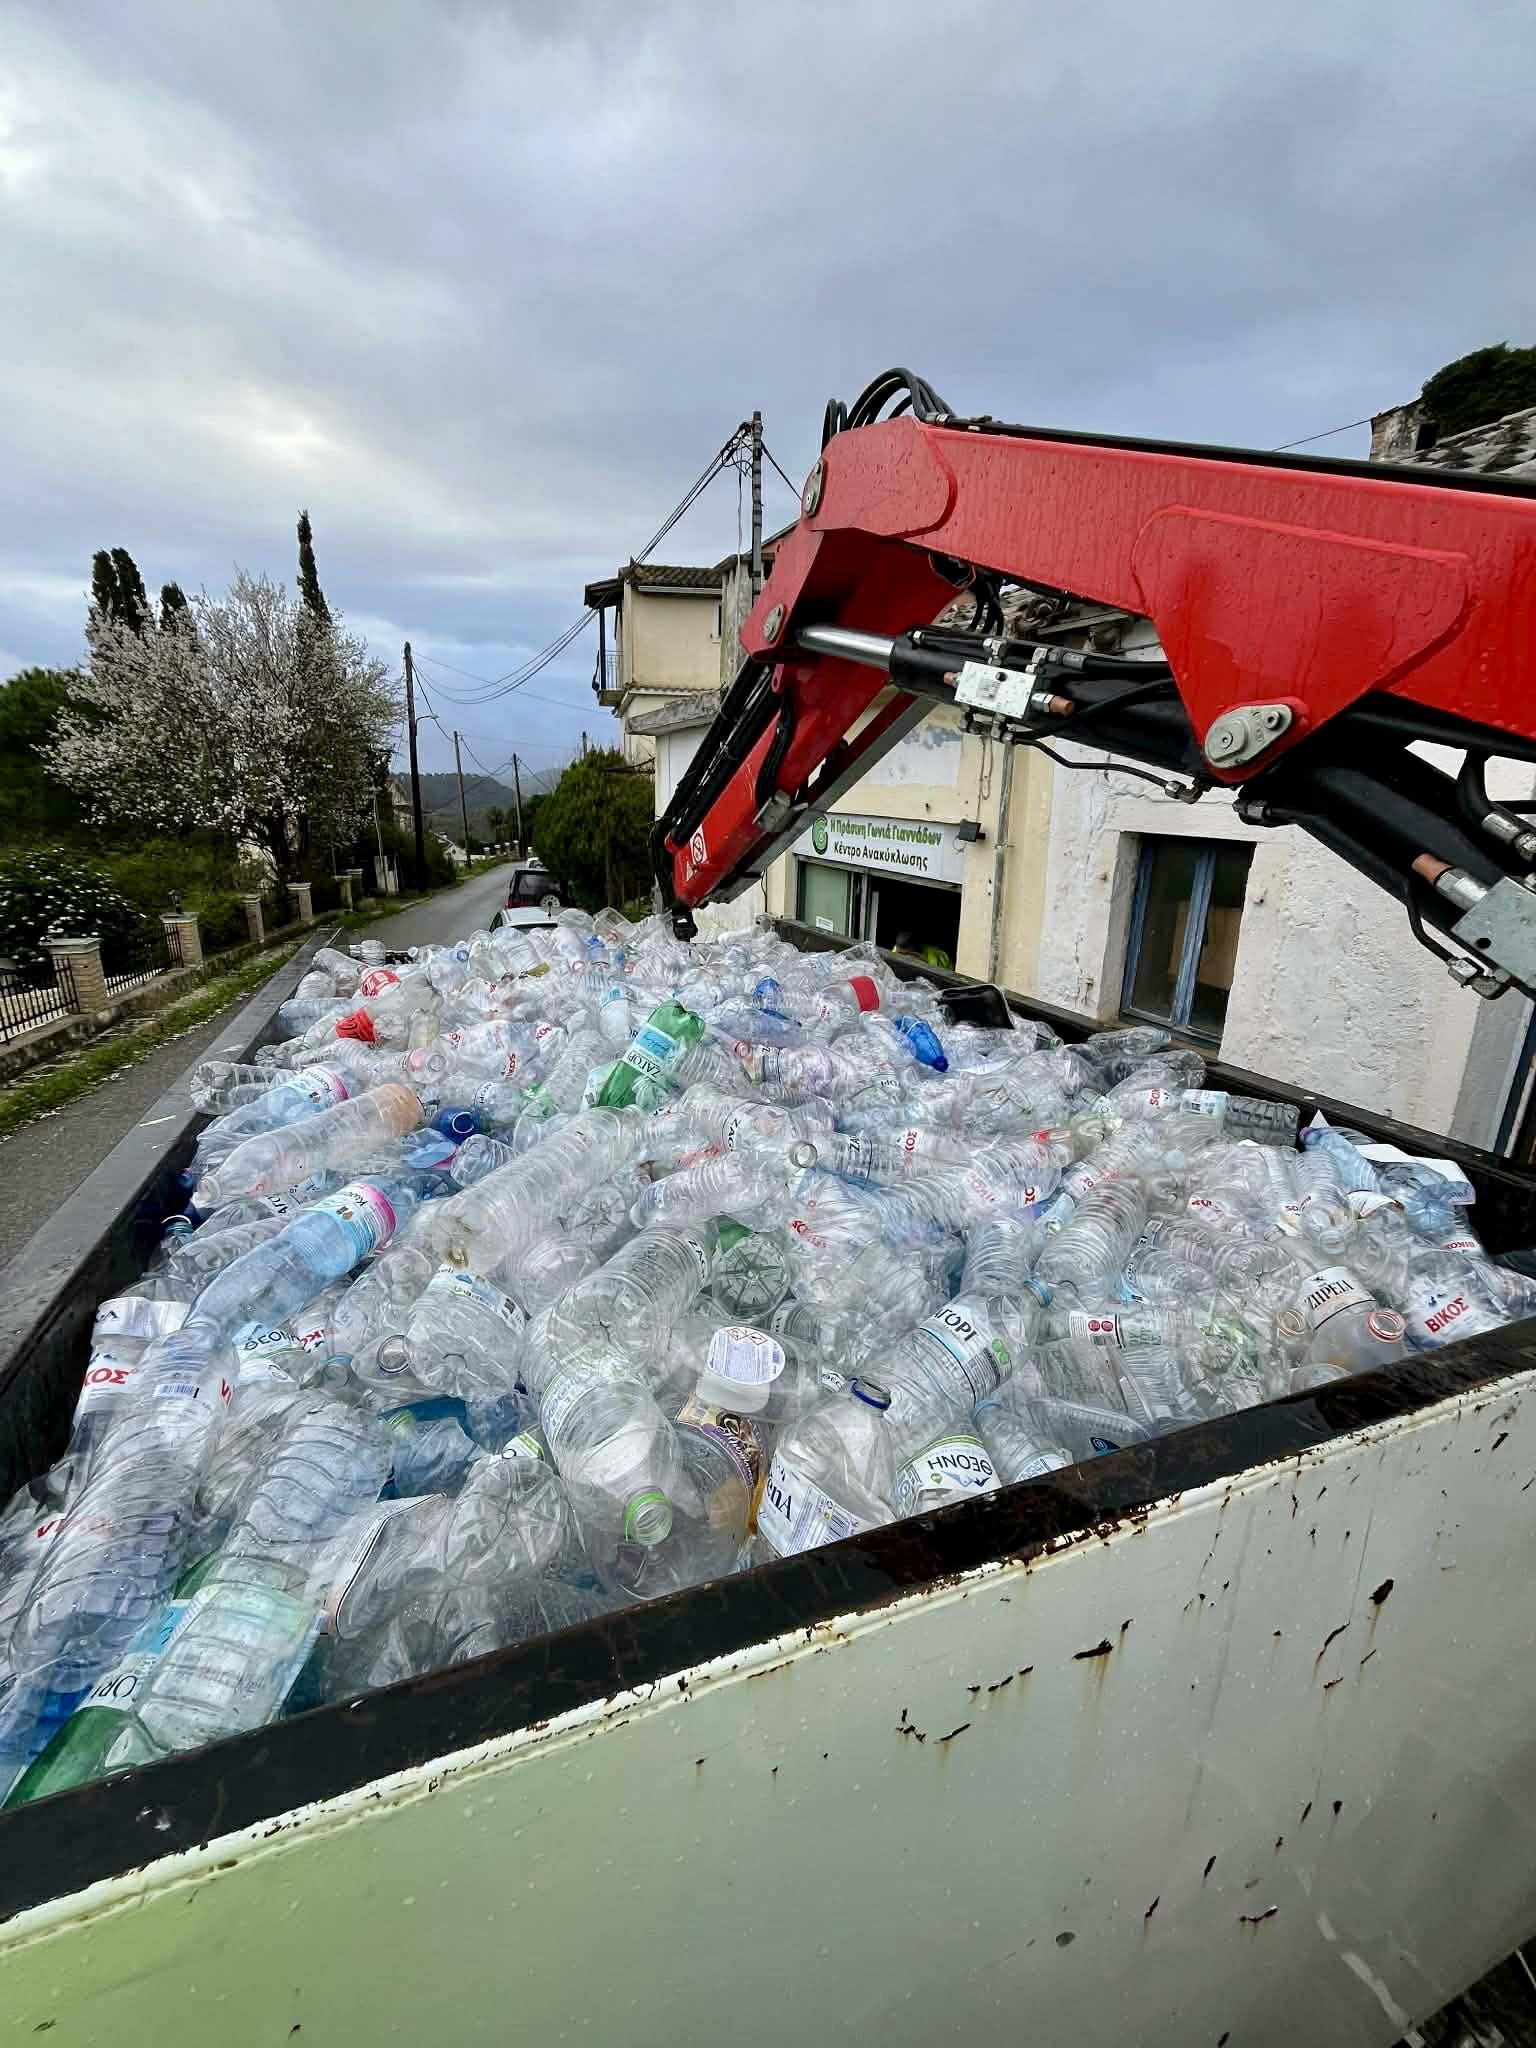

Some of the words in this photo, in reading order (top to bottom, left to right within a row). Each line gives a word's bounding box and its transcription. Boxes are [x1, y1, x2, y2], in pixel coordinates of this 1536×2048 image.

[837, 820, 866, 839] Πράσινη
[867, 822, 891, 840] Γωνιά
[892, 825, 943, 846] Γιαννάδων
[834, 841, 861, 860] Κέντρο
[862, 845, 929, 871] Ανακύκλωσης
[1424, 1297, 1470, 1333] ΒΙΚΟΣ
[927, 1454, 993, 1476] ΘΕΟΝΗ
